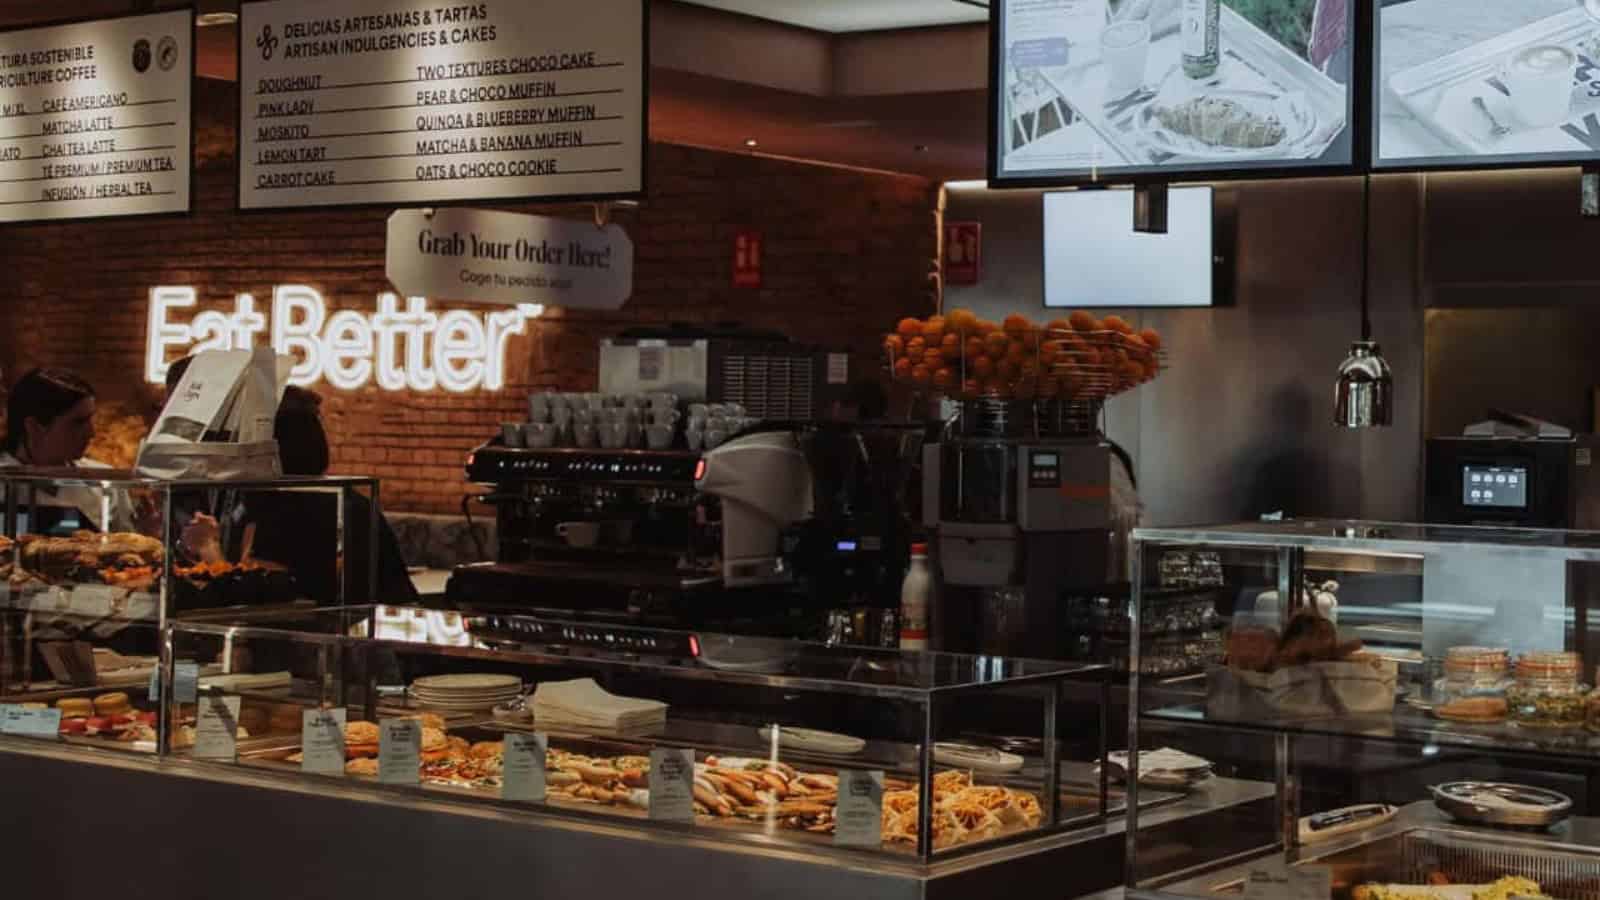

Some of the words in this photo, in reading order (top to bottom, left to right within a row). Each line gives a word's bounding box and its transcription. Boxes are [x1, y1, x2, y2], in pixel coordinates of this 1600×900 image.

[284, 19, 341, 39] DELICIAS
[343, 10, 421, 34] ARTESANAS
[423, 10, 432, 26] &
[435, 4, 488, 23] TARTAS
[284, 40, 338, 60] ARTISAN
[340, 31, 437, 55] INDULGENCIES
[439, 29, 448, 45] &
[451, 25, 497, 44] CAKES
[31, 45, 94, 65] SOSTENIBLE
[55, 64, 96, 82] COFFEE
[416, 65, 446, 81] TWO
[448, 60, 507, 78] TEXTURES
[509, 55, 558, 74] CHOCO
[560, 52, 595, 69] CAKE
[258, 75, 321, 93] DOUGHNUT
[416, 91, 447, 106] PEAR
[449, 89, 457, 103] &
[459, 85, 506, 103] CHOCO
[508, 81, 556, 99] MUFFIN
[68, 91, 128, 110] AMERICANO
[258, 102, 284, 116] PINK
[286, 99, 314, 115] LADY
[42, 119, 82, 136] MATCHA
[84, 116, 113, 132] LATTE
[416, 115, 465, 131] QUINOA
[466, 113, 474, 127] &
[477, 108, 545, 127] BLUEBERRY
[547, 104, 596, 122] MUFFIN
[258, 124, 310, 141] MOSKITO
[416, 138, 467, 155] MATCHA
[469, 137, 477, 153] &
[480, 134, 533, 152] BANANA
[535, 130, 583, 148] MUFFIN
[42, 143, 65, 158] CHAI
[66, 141, 86, 156] TEA
[86, 139, 116, 153] LATTE
[258, 148, 297, 164] LEMON
[299, 146, 327, 162] TART
[55, 161, 99, 178] PREMIUM
[107, 158, 151, 174] PREMIUM
[153, 156, 173, 171] TEA
[416, 164, 447, 180] OATS
[449, 164, 457, 179] &
[459, 161, 506, 178] CHOCO
[508, 158, 558, 175] COOKIE
[258, 171, 304, 188] CARROT
[304, 170, 335, 186] CAKE
[95, 183, 132, 198] HERBAL
[134, 181, 153, 196] TEA
[418, 229, 465, 258] Grab
[470, 231, 513, 261] Your
[515, 238, 566, 265] Order
[459, 268, 492, 287] Coge
[494, 272, 507, 286] tu
[147, 286, 264, 385] Eat
[272, 285, 524, 392] Better
